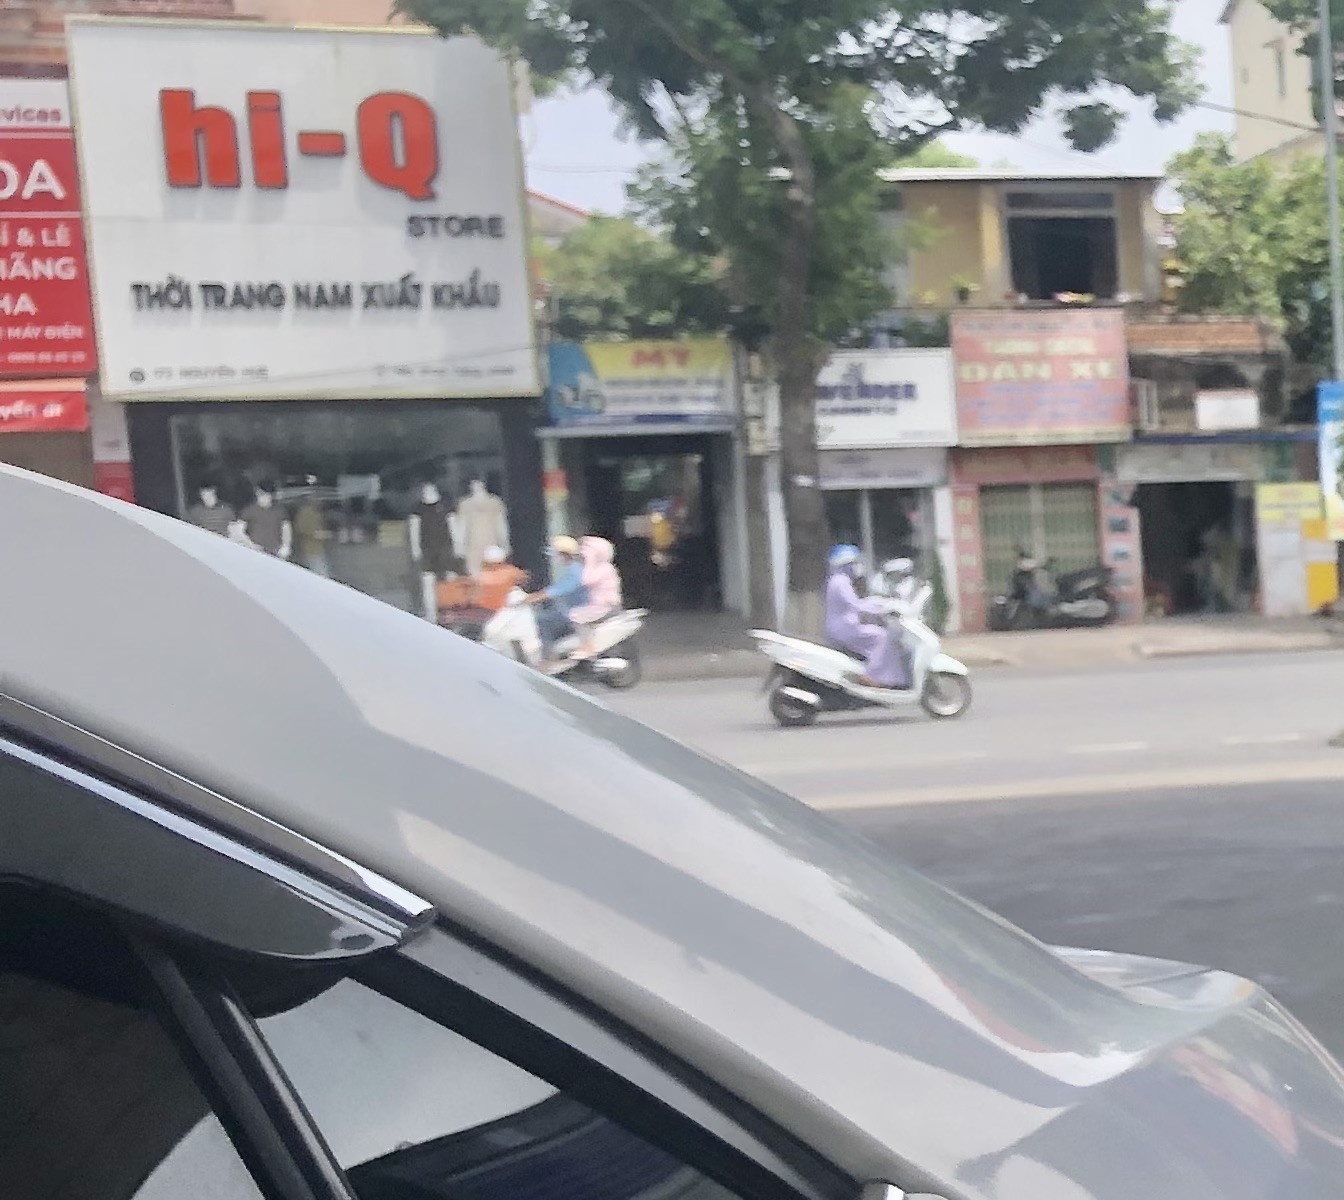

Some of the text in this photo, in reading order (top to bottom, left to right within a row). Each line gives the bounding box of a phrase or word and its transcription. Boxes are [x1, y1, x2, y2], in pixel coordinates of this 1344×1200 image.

[159, 88, 439, 200] hi-Q
[408, 214, 504, 239] STORE
[200, 280, 286, 311] TRANG
[294, 280, 352, 310] NAM
